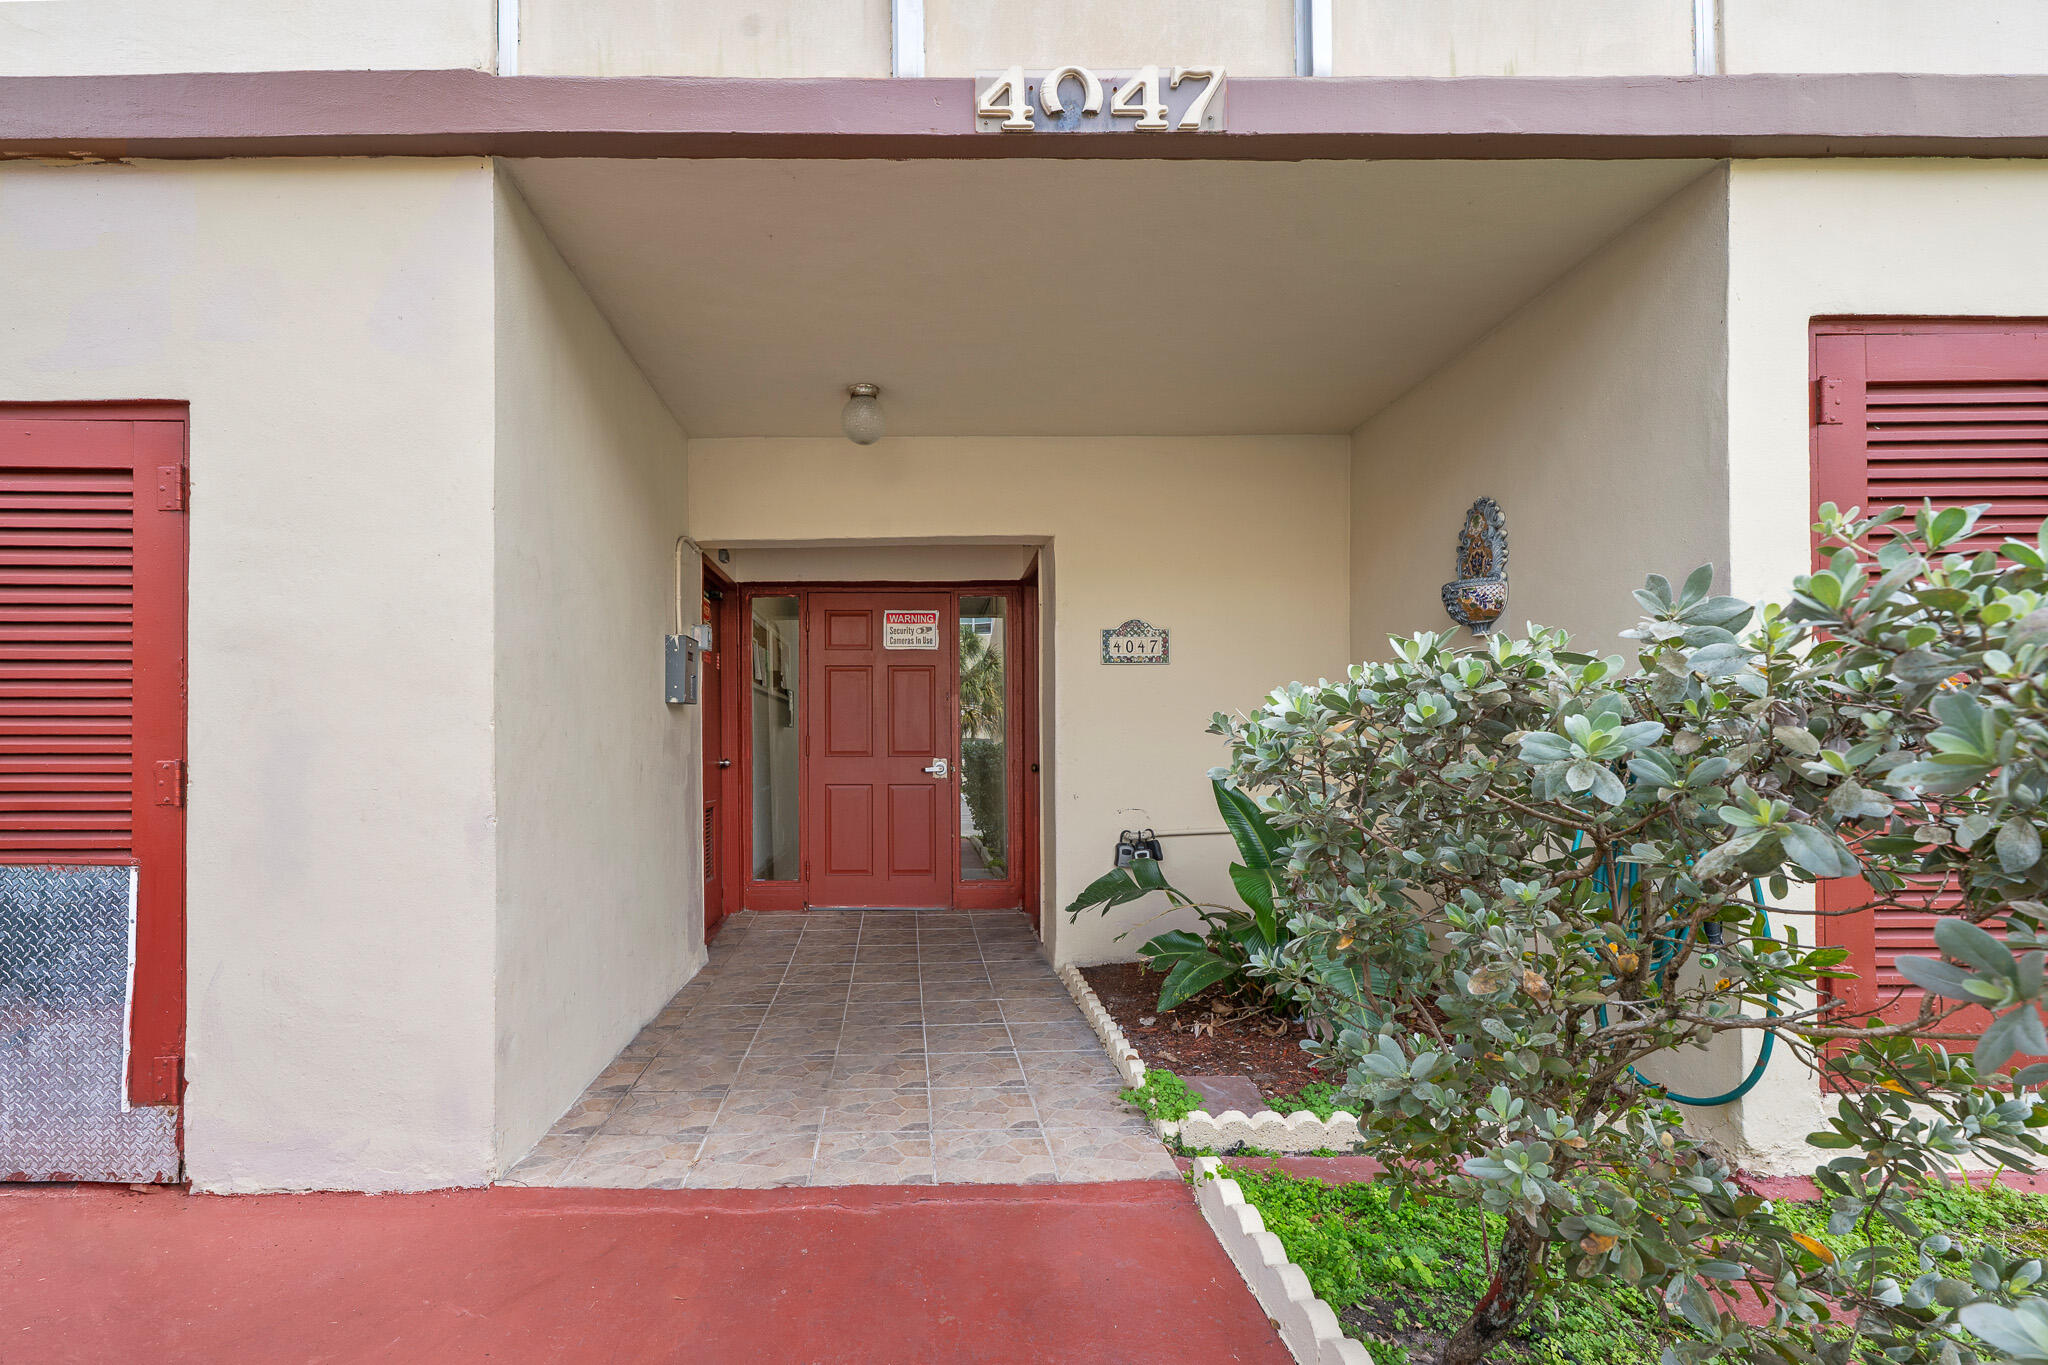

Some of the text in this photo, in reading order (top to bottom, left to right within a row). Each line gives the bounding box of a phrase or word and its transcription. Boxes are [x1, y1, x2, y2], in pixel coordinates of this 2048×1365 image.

[978, 65, 1226, 131] 4047
[889, 614, 934, 623] WARNING
[890, 626, 915, 636] Security
[890, 636, 915, 645] Cameras
[923, 636, 933, 645] Use
[1113, 640, 1158, 653] 4047
